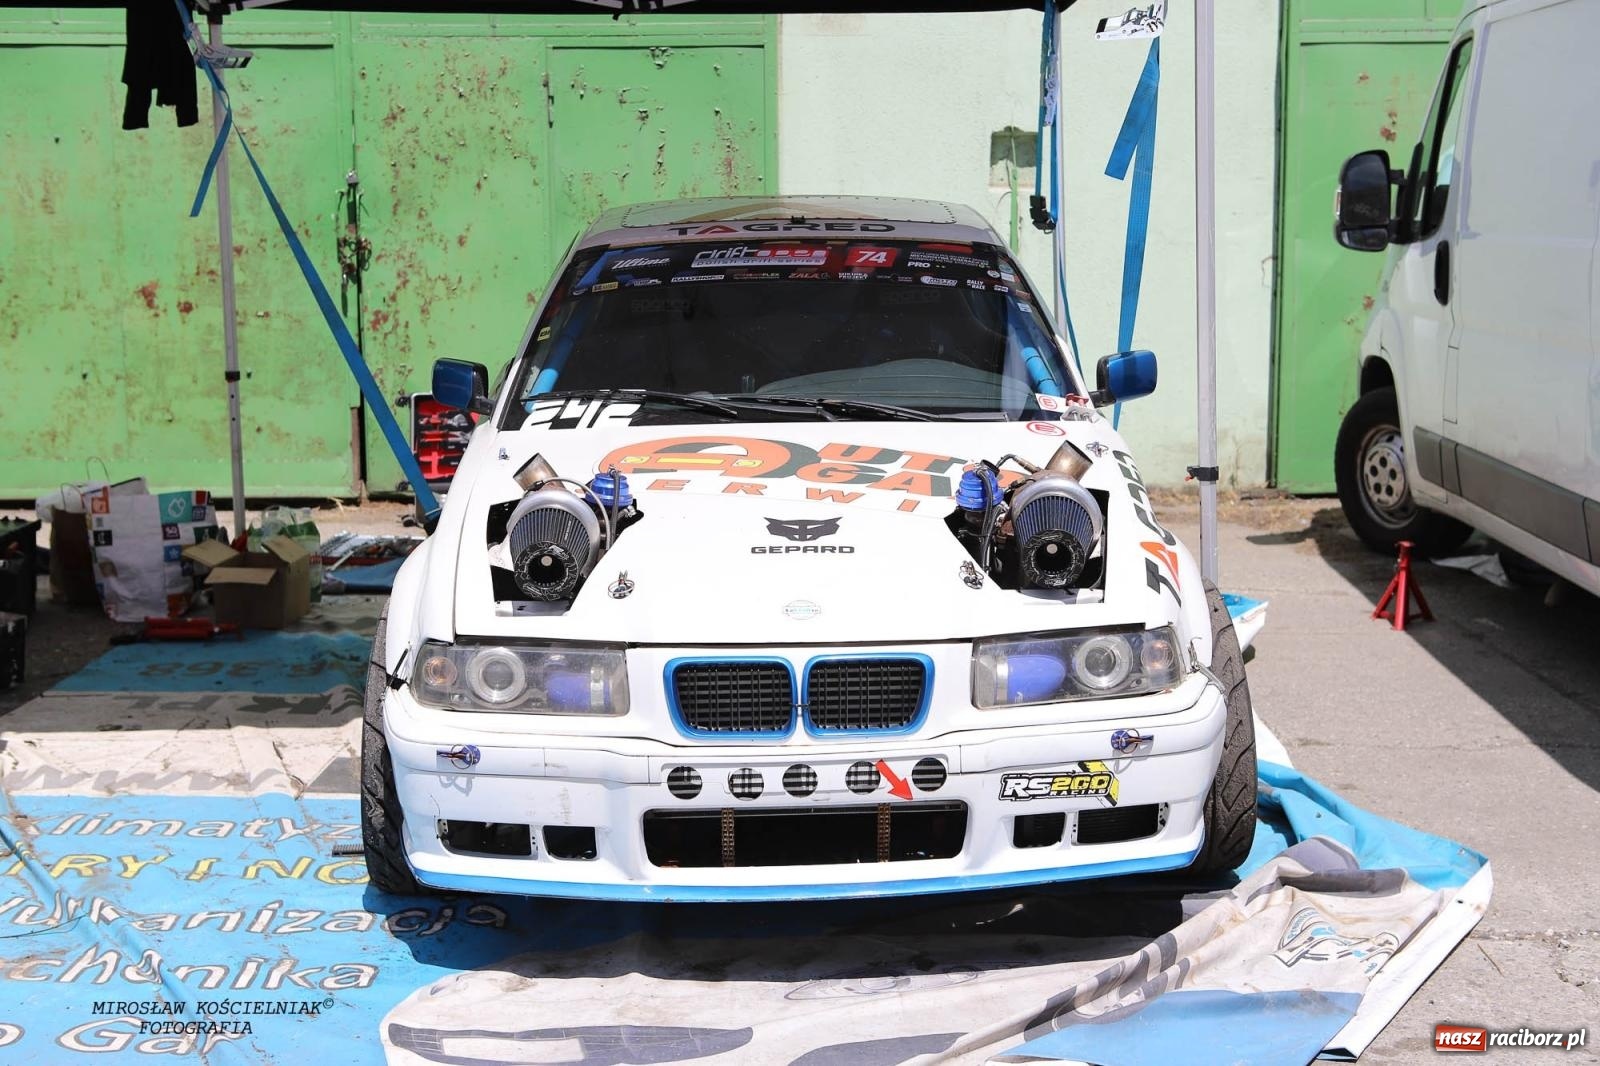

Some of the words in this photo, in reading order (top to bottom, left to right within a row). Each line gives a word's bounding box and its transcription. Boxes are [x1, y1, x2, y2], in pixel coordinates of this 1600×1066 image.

[667, 222, 896, 236] TAGRED
[695, 246, 758, 259] drift
[855, 250, 887, 264] 74
[751, 545, 855, 554] GEPARD
[1002, 775, 1111, 798] RS200
